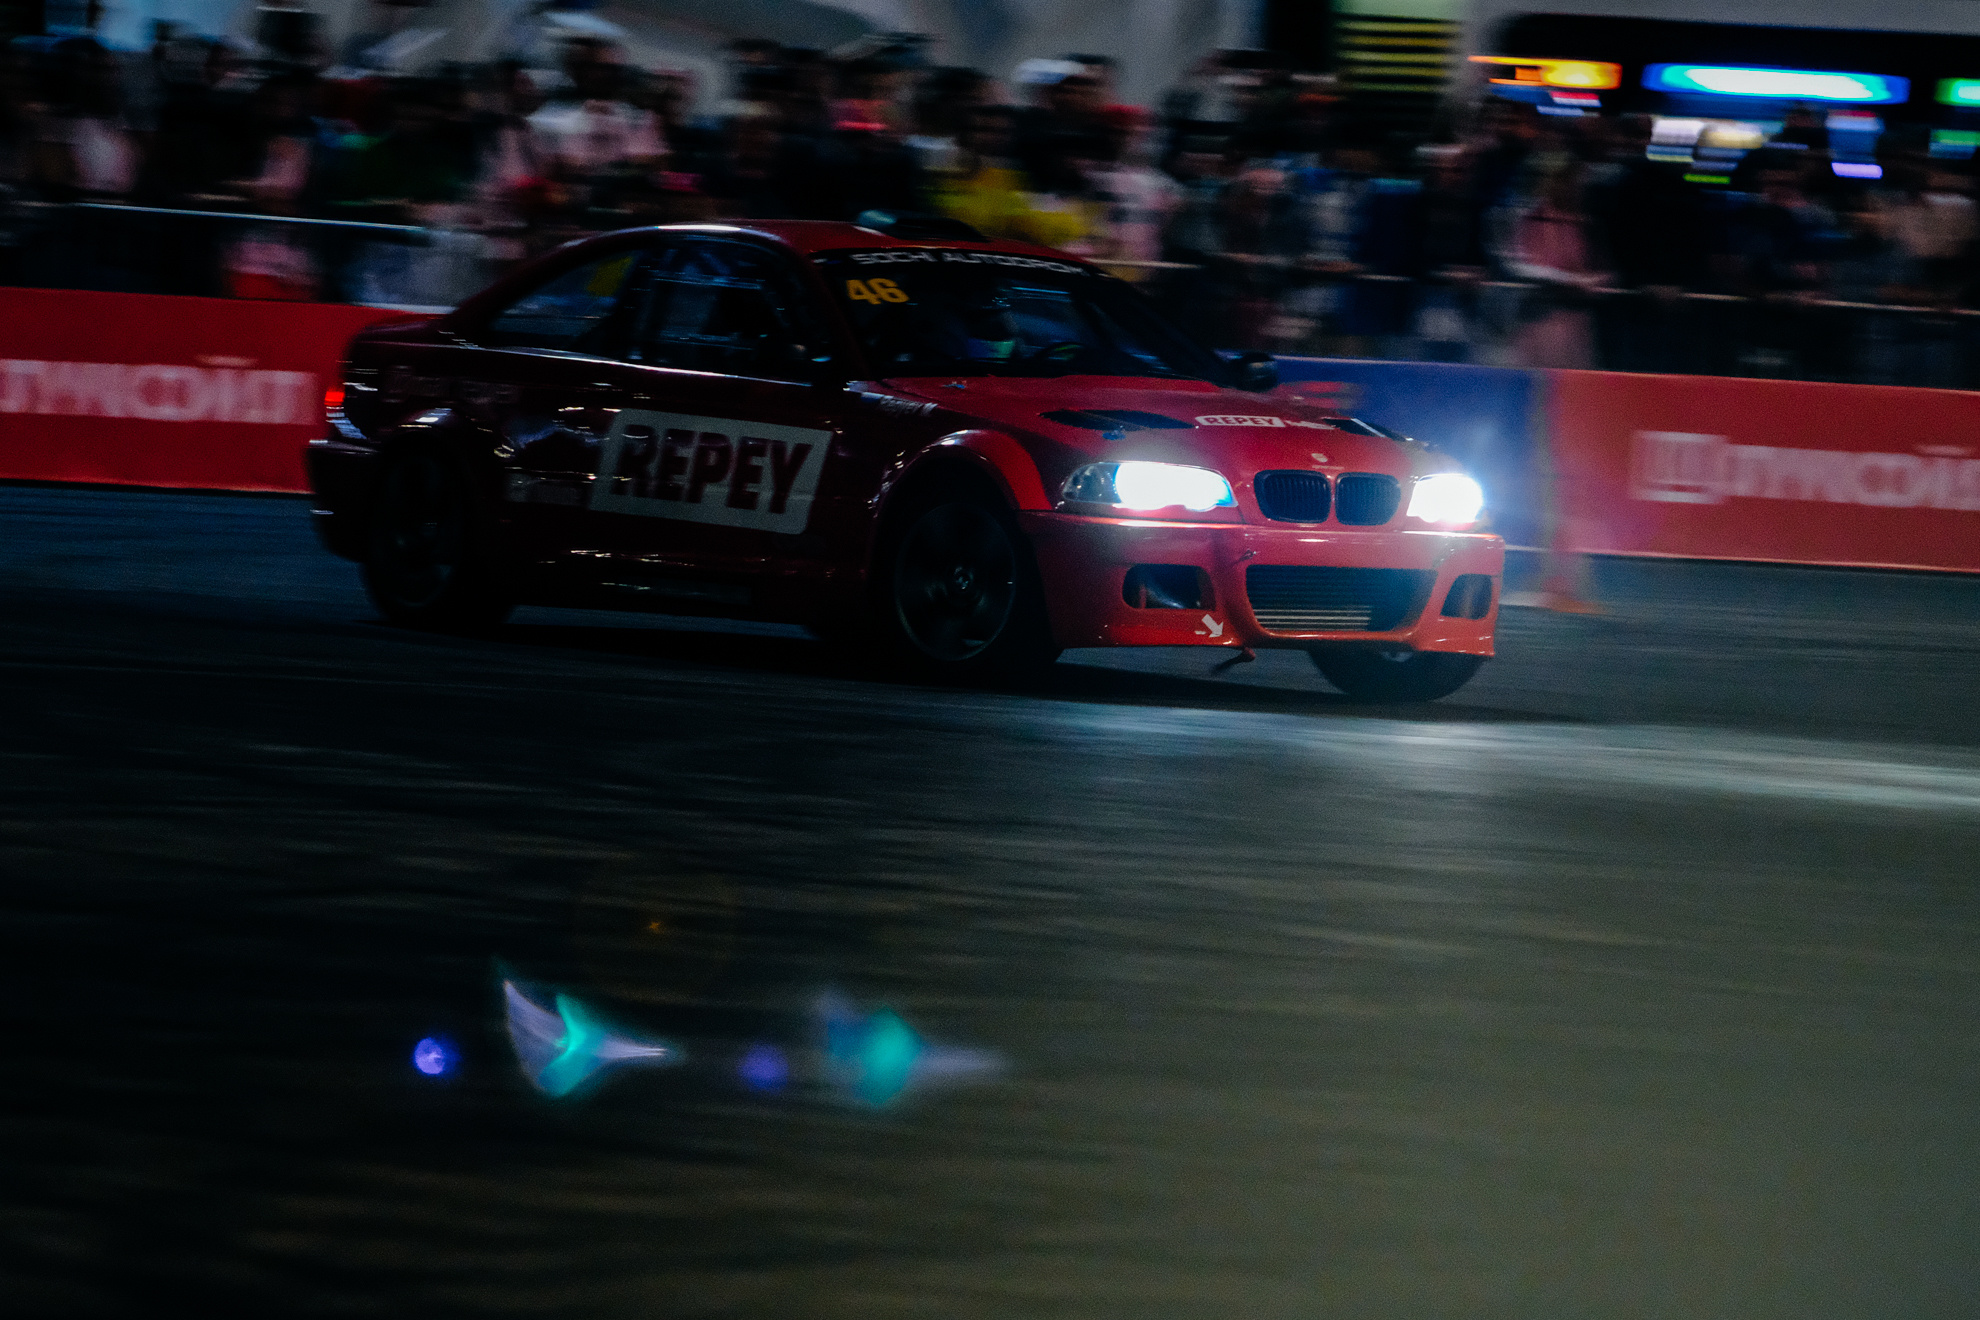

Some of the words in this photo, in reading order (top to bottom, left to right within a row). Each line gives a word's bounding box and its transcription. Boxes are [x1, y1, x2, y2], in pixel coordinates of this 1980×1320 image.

[850, 252, 937, 266] SOCHI
[941, 252, 1091, 277] AUTODROM
[845, 277, 910, 306] 46
[1203, 416, 1276, 427] REPEY
[611, 423, 812, 514] REPEY
